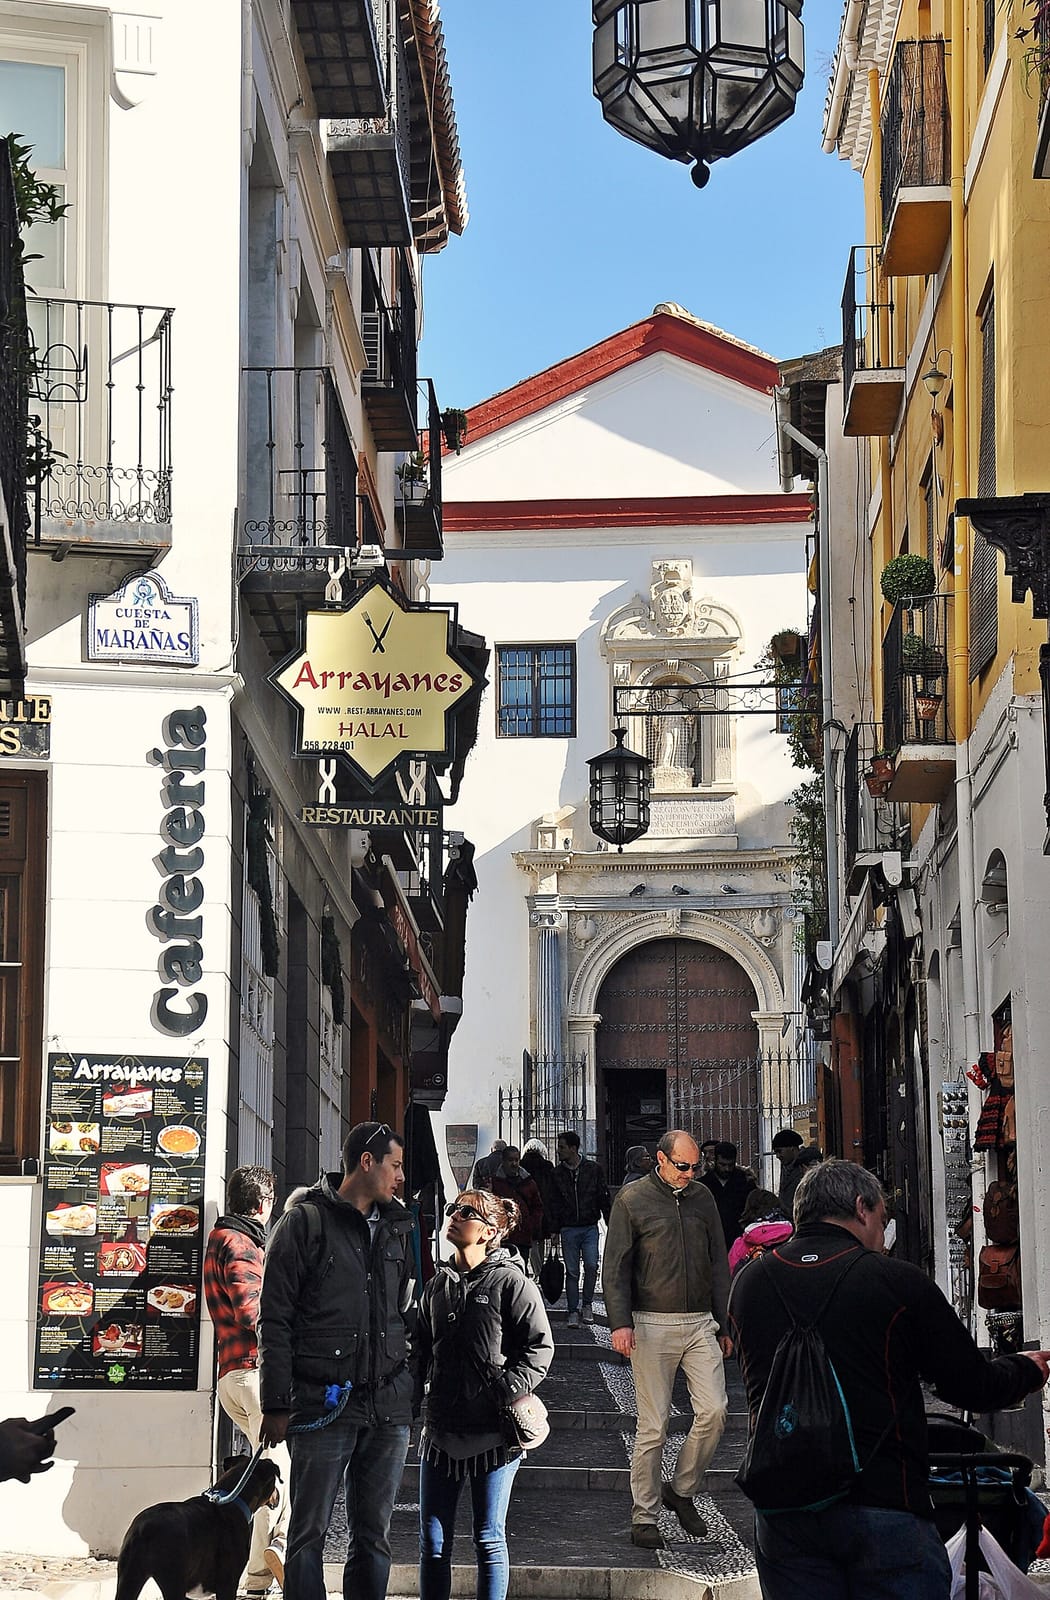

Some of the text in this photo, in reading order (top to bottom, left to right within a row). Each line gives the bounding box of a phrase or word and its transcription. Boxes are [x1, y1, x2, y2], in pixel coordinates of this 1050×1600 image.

[115, 607, 172, 620] CUESTA
[134, 619, 150, 629] DE
[97, 628, 190, 651] MARAÑAS
[292, 660, 463, 699] Arrayanes
[338, 721, 410, 739] HALAL
[301, 807, 439, 827] RESTAURANTE
[74, 1058, 183, 1088] Arrayanes
